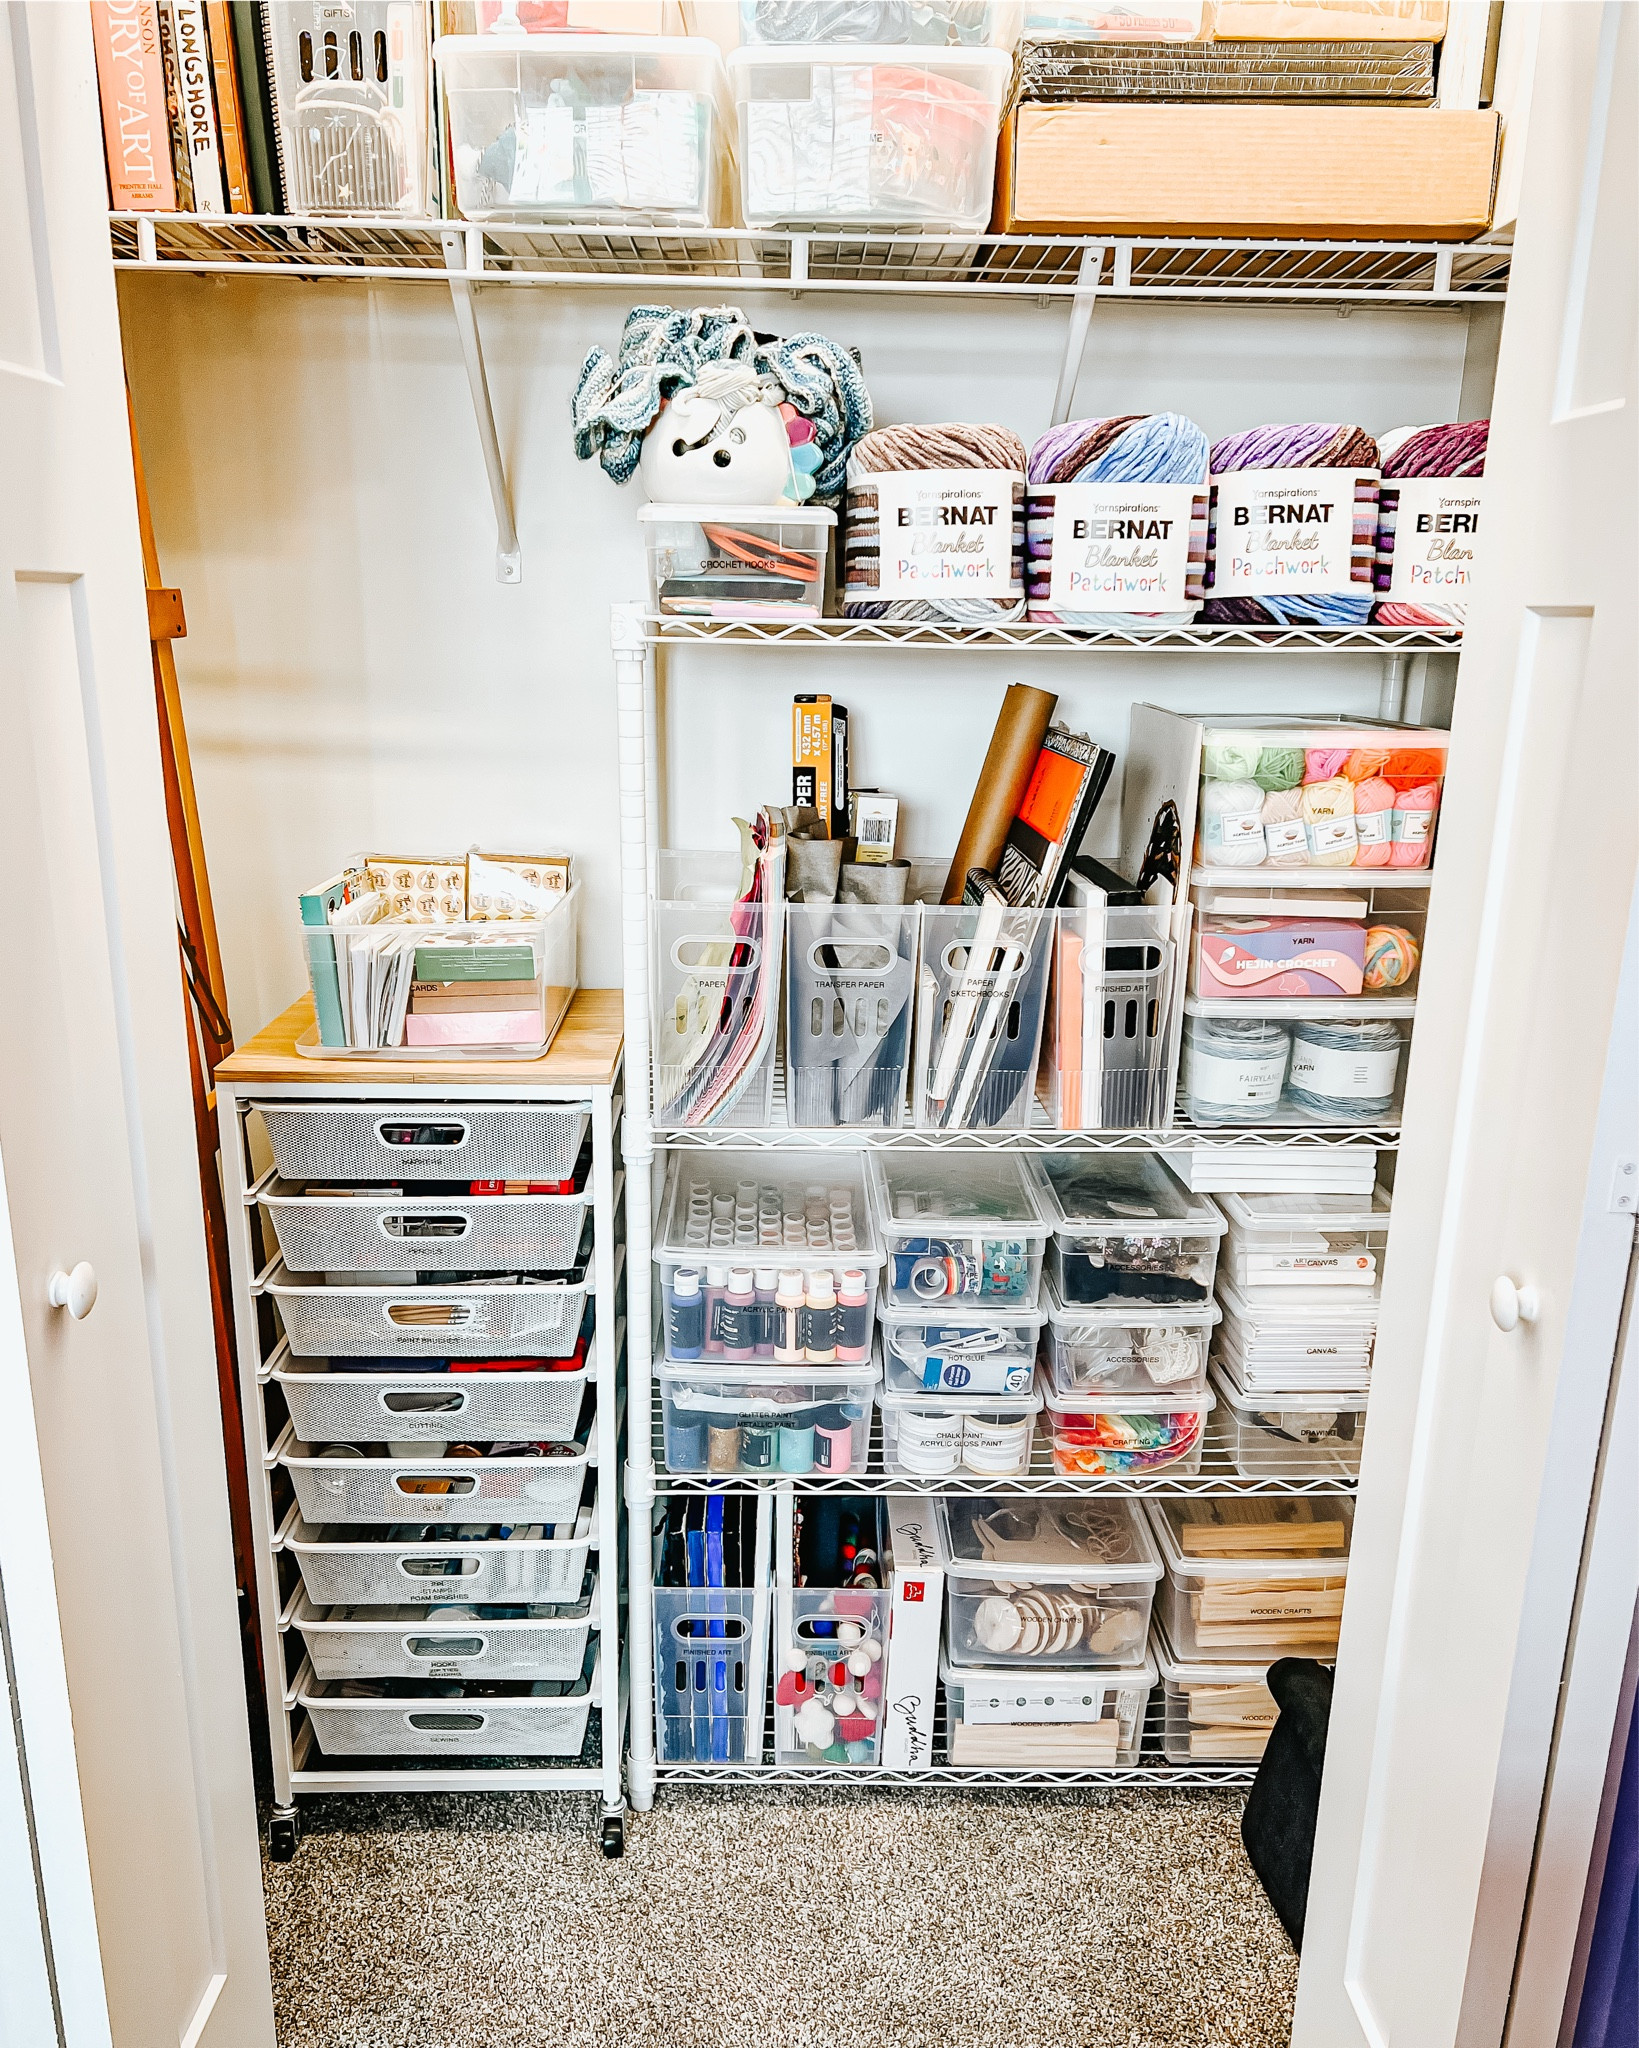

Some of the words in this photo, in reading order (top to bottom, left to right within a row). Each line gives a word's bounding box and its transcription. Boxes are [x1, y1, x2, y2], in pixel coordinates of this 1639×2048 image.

[323, 9, 350, 18] GIFTS
[139, 5, 156, 55] NSON
[126, 71, 147, 105] OF
[178, 9, 210, 156] LONGSHORE
[118, 100, 156, 182] ART
[1252, 488, 1319, 500] Yarnspirations
[898, 506, 998, 526] BERNAT
[1093, 503, 1159, 514] Yarnspirations
[1234, 503, 1334, 526] BERNAT
[1073, 520, 1174, 540] BERNAT
[911, 531, 984, 556] Blanket
[1245, 528, 1320, 553] Blanket
[700, 560, 742, 569] CROCHET
[745, 560, 775, 569] HOOKS
[1084, 544, 1159, 568] Blanket
[1070, 572, 1168, 592] Patchwork
[1411, 565, 1471, 584] Patch
[803, 715, 811, 733] mm
[813, 714, 821, 724] m
[802, 736, 811, 756] 432
[812, 725, 821, 748] 4.57
[796, 775, 811, 807] PER
[820, 781, 828, 802] FREE
[1292, 937, 1315, 945] YARN
[1236, 959, 1274, 970] HEJIN
[1276, 958, 1338, 969] CROCHET
[410, 984, 438, 992] CARDS
[699, 980, 726, 988] PAPER
[950, 990, 1010, 998] SKETCHBOOKS
[1095, 985, 1131, 993] FINISHED
[1132, 984, 1150, 992] ART
[1307, 1259, 1338, 1267] CANVAS
[1010, 1374, 1023, 1389] 40
[896, 1523, 935, 1568] Buddha
[893, 1695, 927, 1767] Buddha
